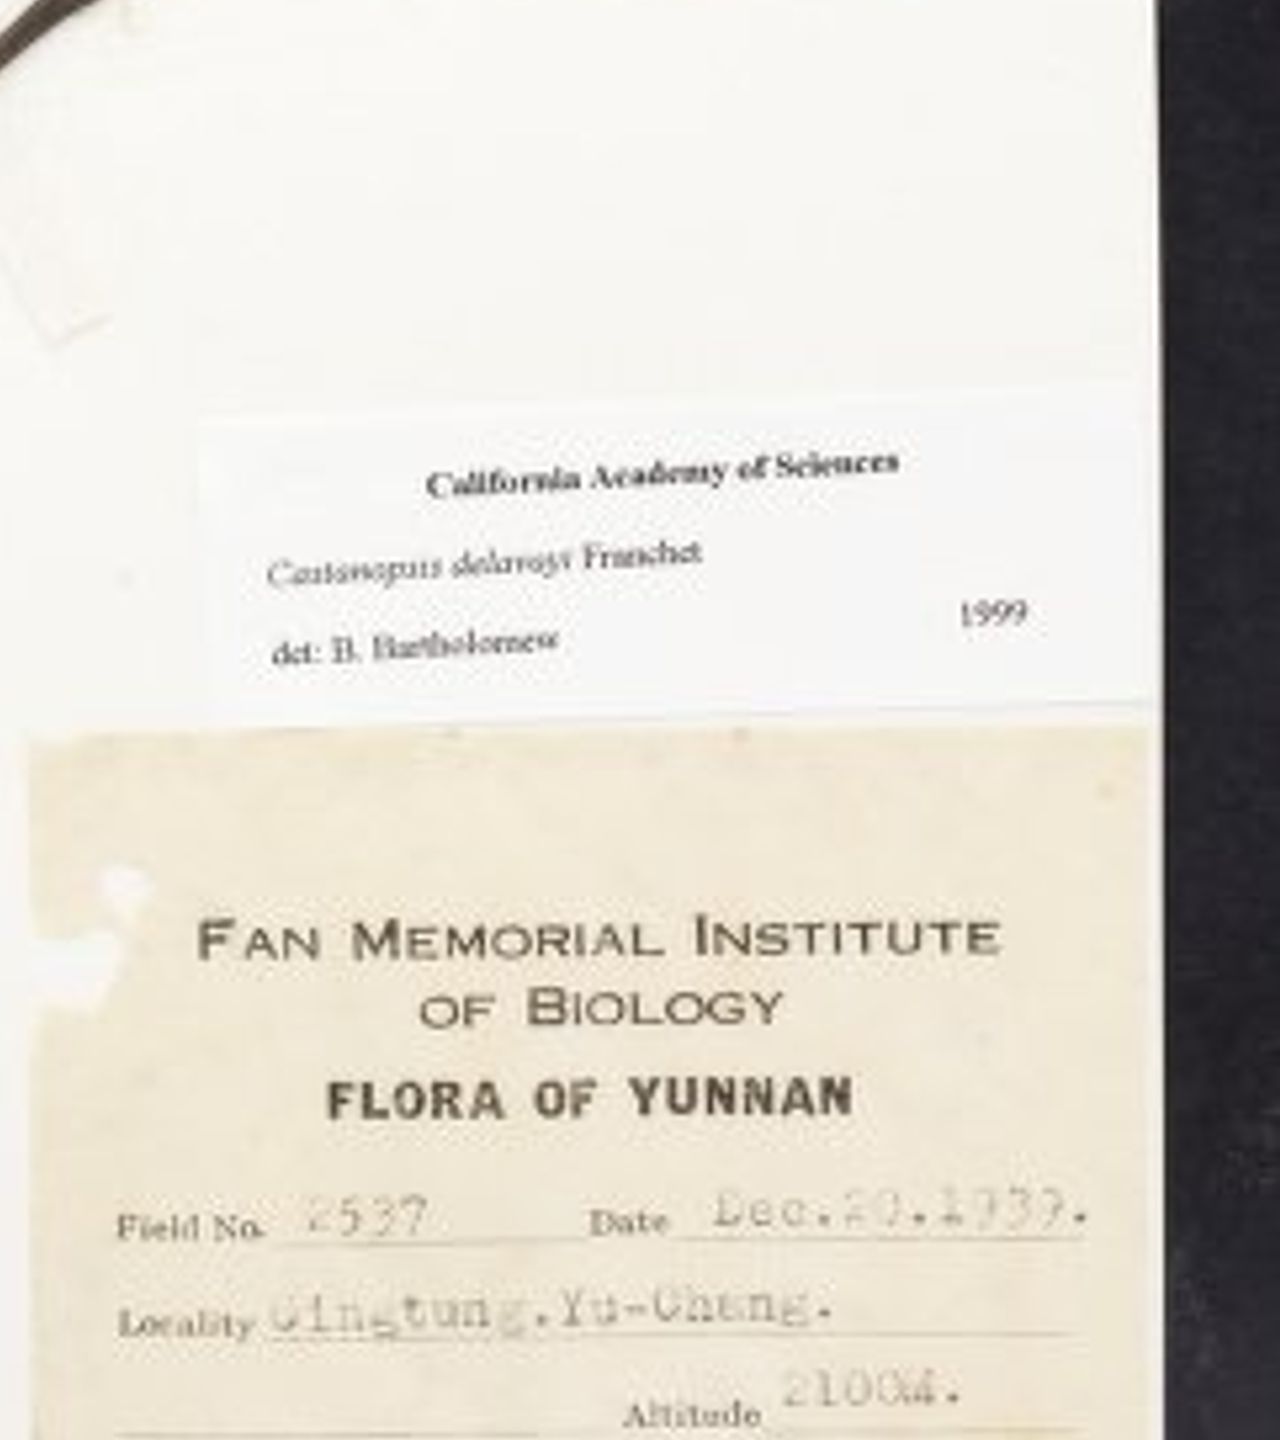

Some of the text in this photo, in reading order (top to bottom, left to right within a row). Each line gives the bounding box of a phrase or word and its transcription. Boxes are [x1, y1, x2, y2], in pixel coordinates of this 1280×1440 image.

[424, 449, 901, 502] California Academy of Sciences
[266, 540, 704, 590] Castanopsis delavayi Franchet
[959, 599, 1028, 630] 1999
[271, 627, 561, 668] det: B. Bartholomew
[197, 913, 1003, 961] FAN MEMORIAL INSTITUTE
[526, 986, 786, 1028] BIOLOGY
[326, 1075, 853, 1121] FLORA OF YUNNAN
[116, 1194, 431, 1244] Field No. 2537
[589, 1209, 671, 1238] Date
[118, 1308, 255, 1341] Locality
[622, 1400, 763, 1429] Altitude
